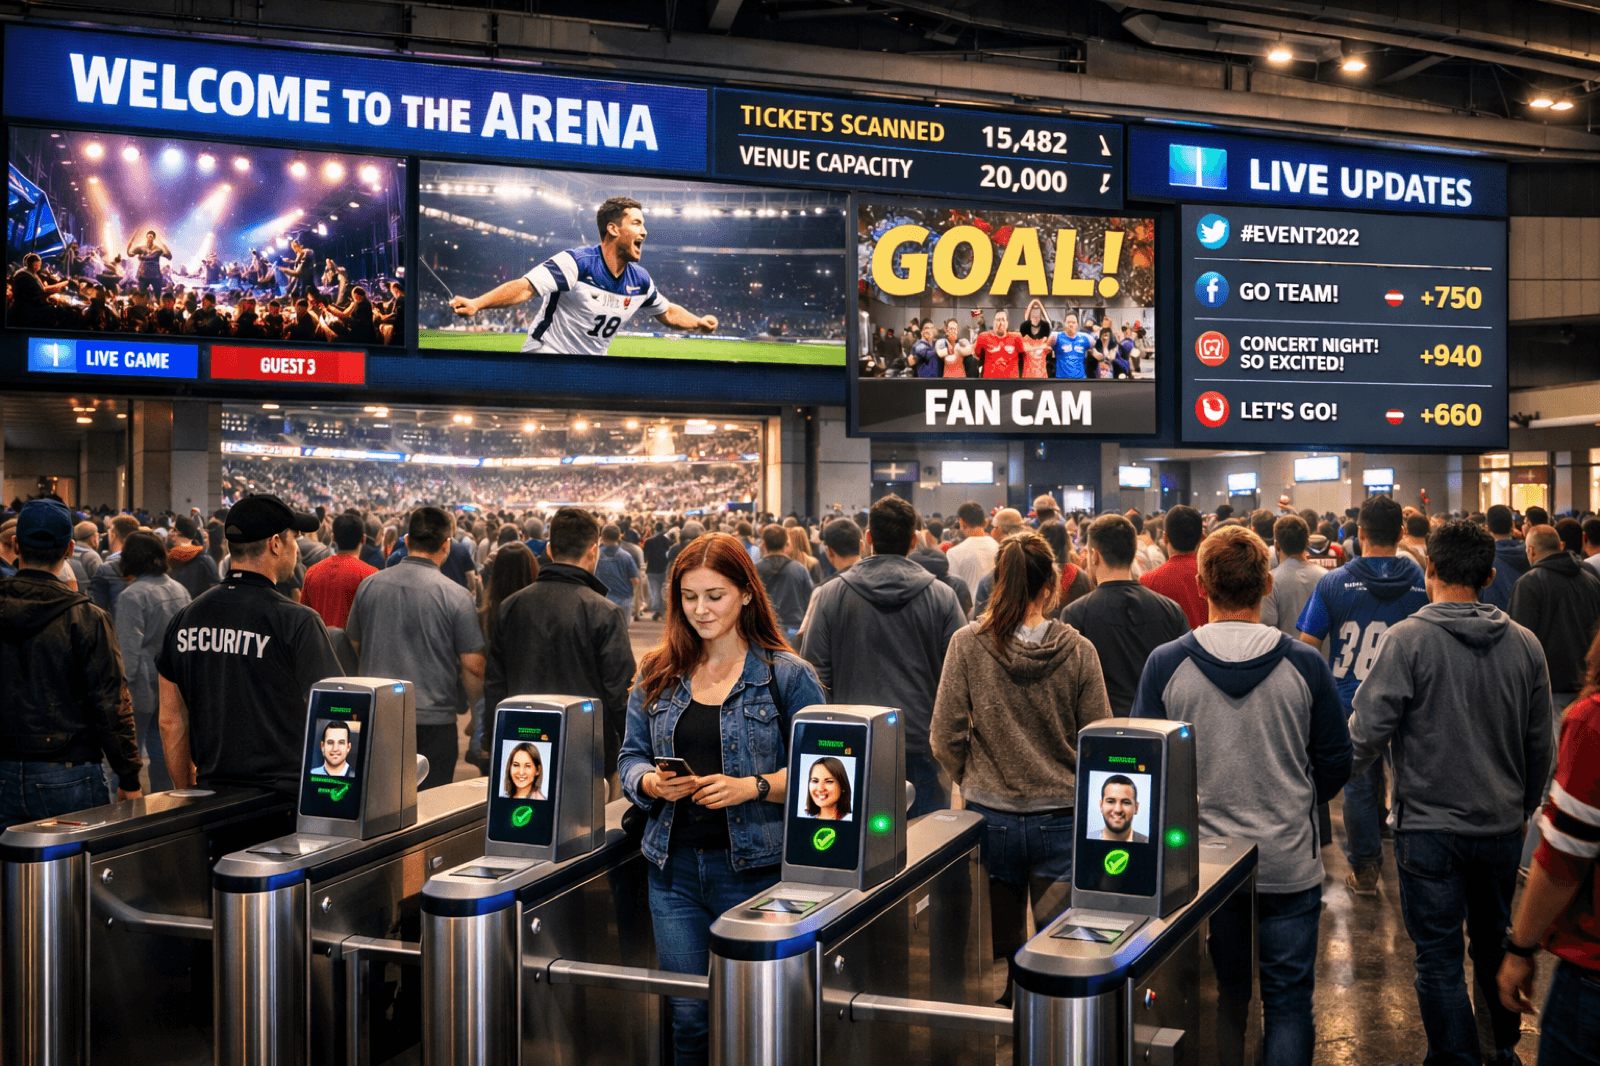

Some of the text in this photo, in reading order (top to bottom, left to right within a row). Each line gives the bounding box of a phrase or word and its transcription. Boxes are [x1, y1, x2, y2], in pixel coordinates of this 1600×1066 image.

[70, 53, 658, 150] WELCOME TO THE ARENA
[741, 105, 1067, 154] TICKETS SCANNED 15,482
[740, 146, 1067, 192] VENUE CAPACITY 20,000
[1251, 159, 1471, 206] LIVE UPDATES
[1240, 225, 1359, 245] #EVENT2022
[870, 223, 1125, 298] GOAL!
[1240, 283, 1482, 309] GO TEAM! +750
[587, 315, 621, 338] 18
[1240, 336, 1379, 354] CONCERT NIGHT!
[1420, 344, 1482, 367] +940
[87, 350, 169, 368] LIVE GAME
[260, 357, 315, 375] GUEST 3
[1241, 354, 1344, 371] SO EXCITED!
[926, 389, 1091, 425] FAN CAM
[1241, 402, 1482, 426] LET'S GO! +660
[178, 627, 270, 658] SECURITY
